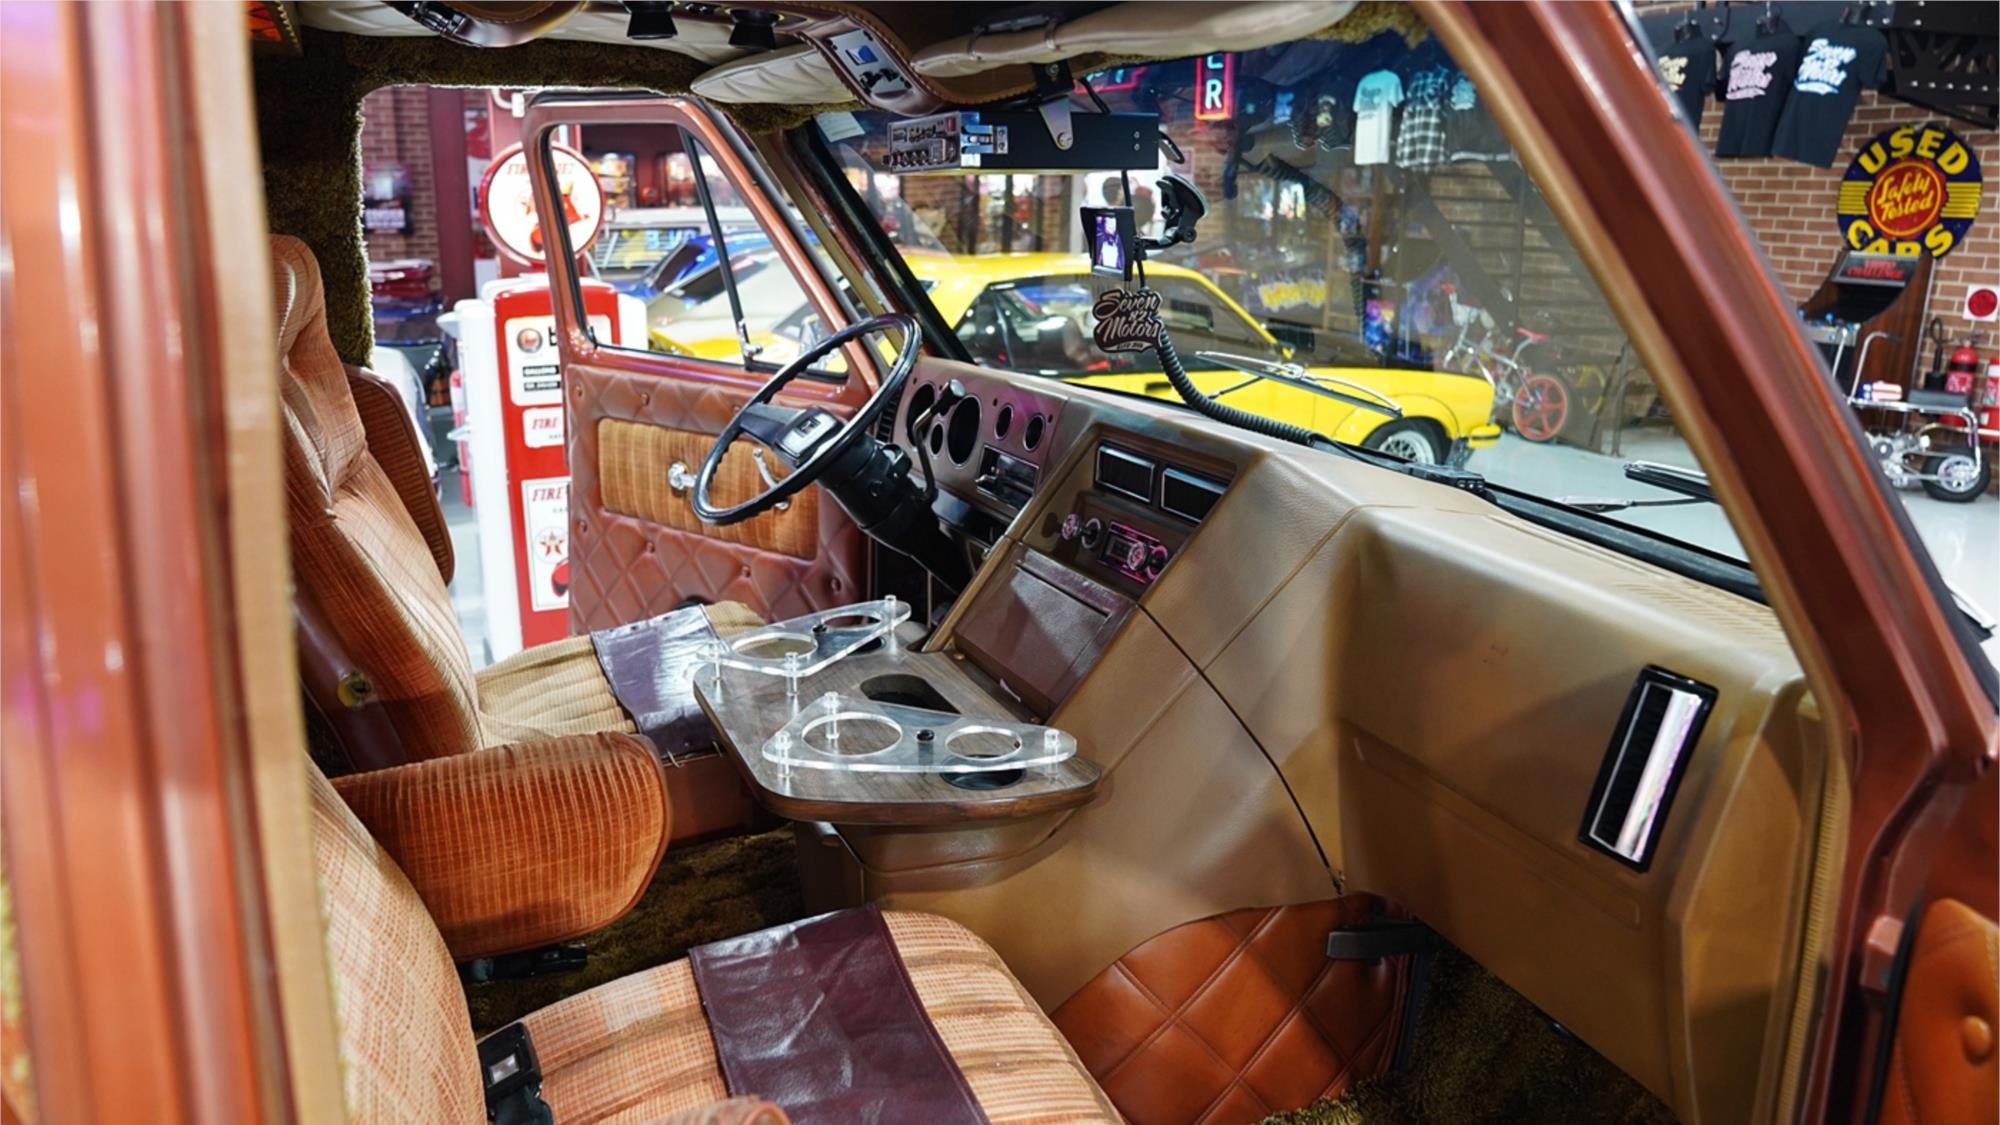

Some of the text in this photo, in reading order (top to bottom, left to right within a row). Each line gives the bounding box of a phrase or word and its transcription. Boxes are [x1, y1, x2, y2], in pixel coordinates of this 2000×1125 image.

[1858, 127, 1970, 175] USED
[1877, 171, 1931, 205] Safety
[1881, 190, 1935, 222] Tested
[1847, 219, 1954, 258] CARS
[1094, 292, 1159, 319] Seven
[1096, 316, 1160, 343] Motors
